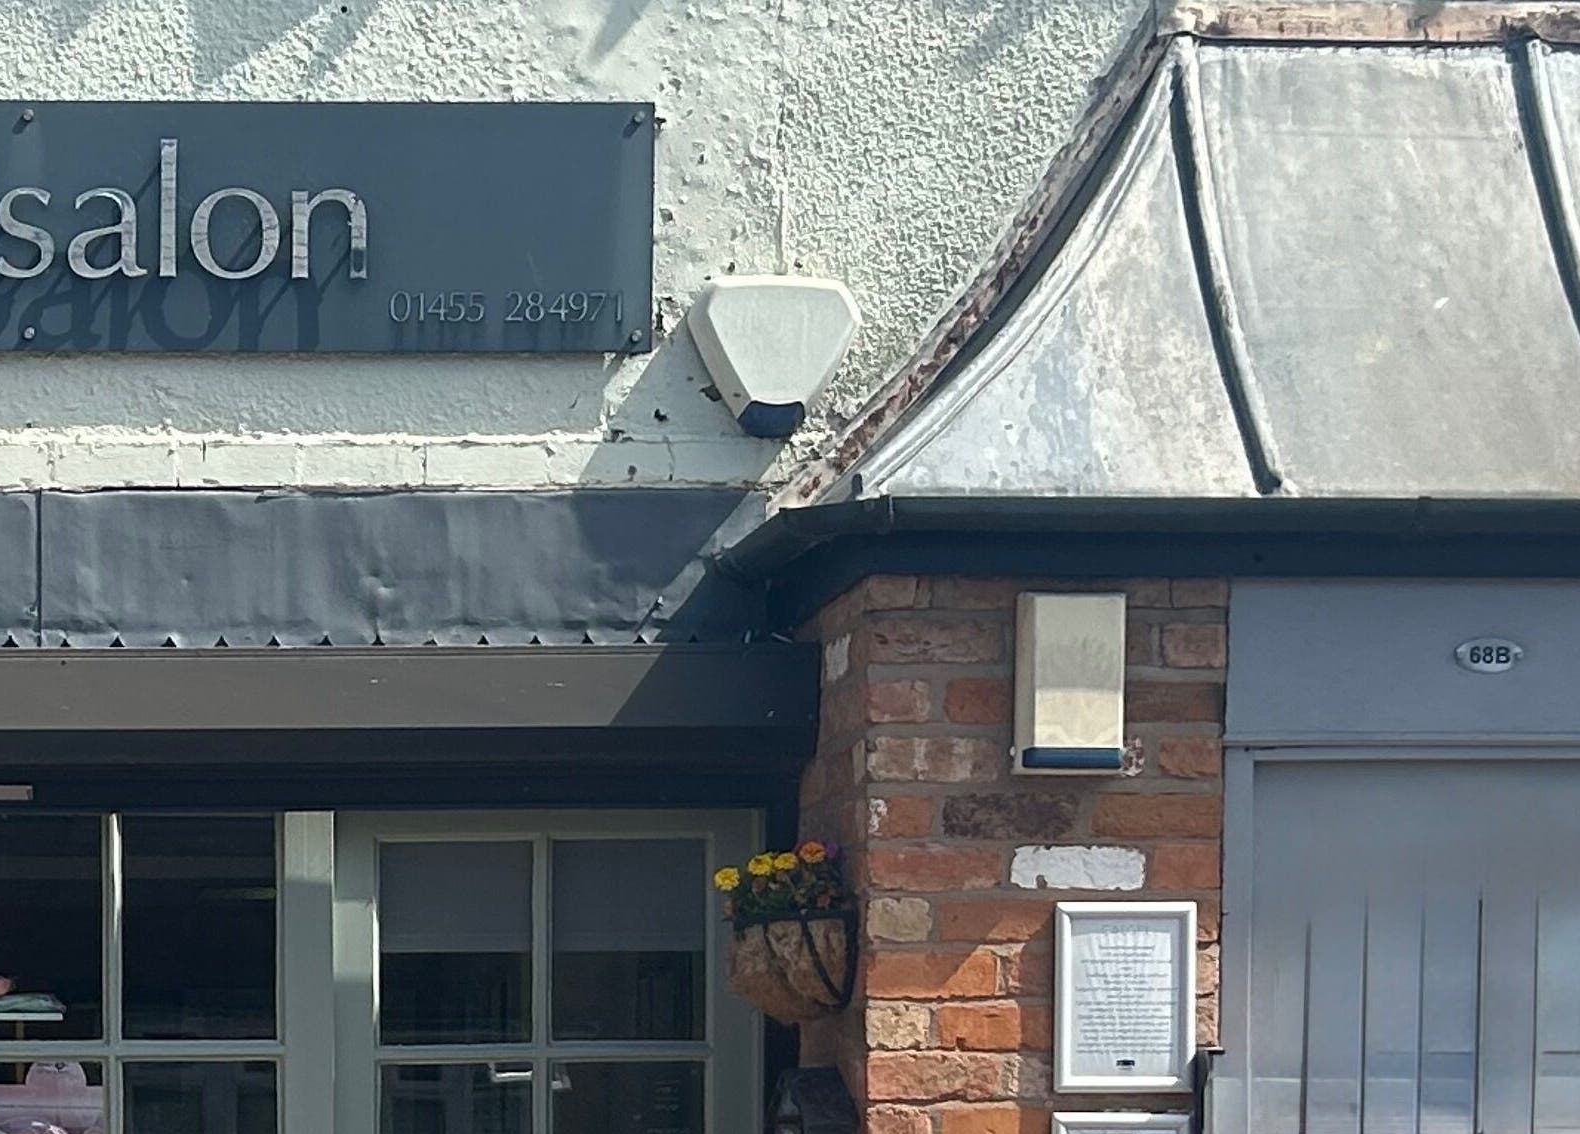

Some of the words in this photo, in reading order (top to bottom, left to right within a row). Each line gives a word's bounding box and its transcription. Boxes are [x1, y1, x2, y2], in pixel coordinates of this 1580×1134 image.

[390, 291, 485, 323] 01455
[505, 291, 624, 323] 284971
[1469, 645, 1511, 664] 68B
